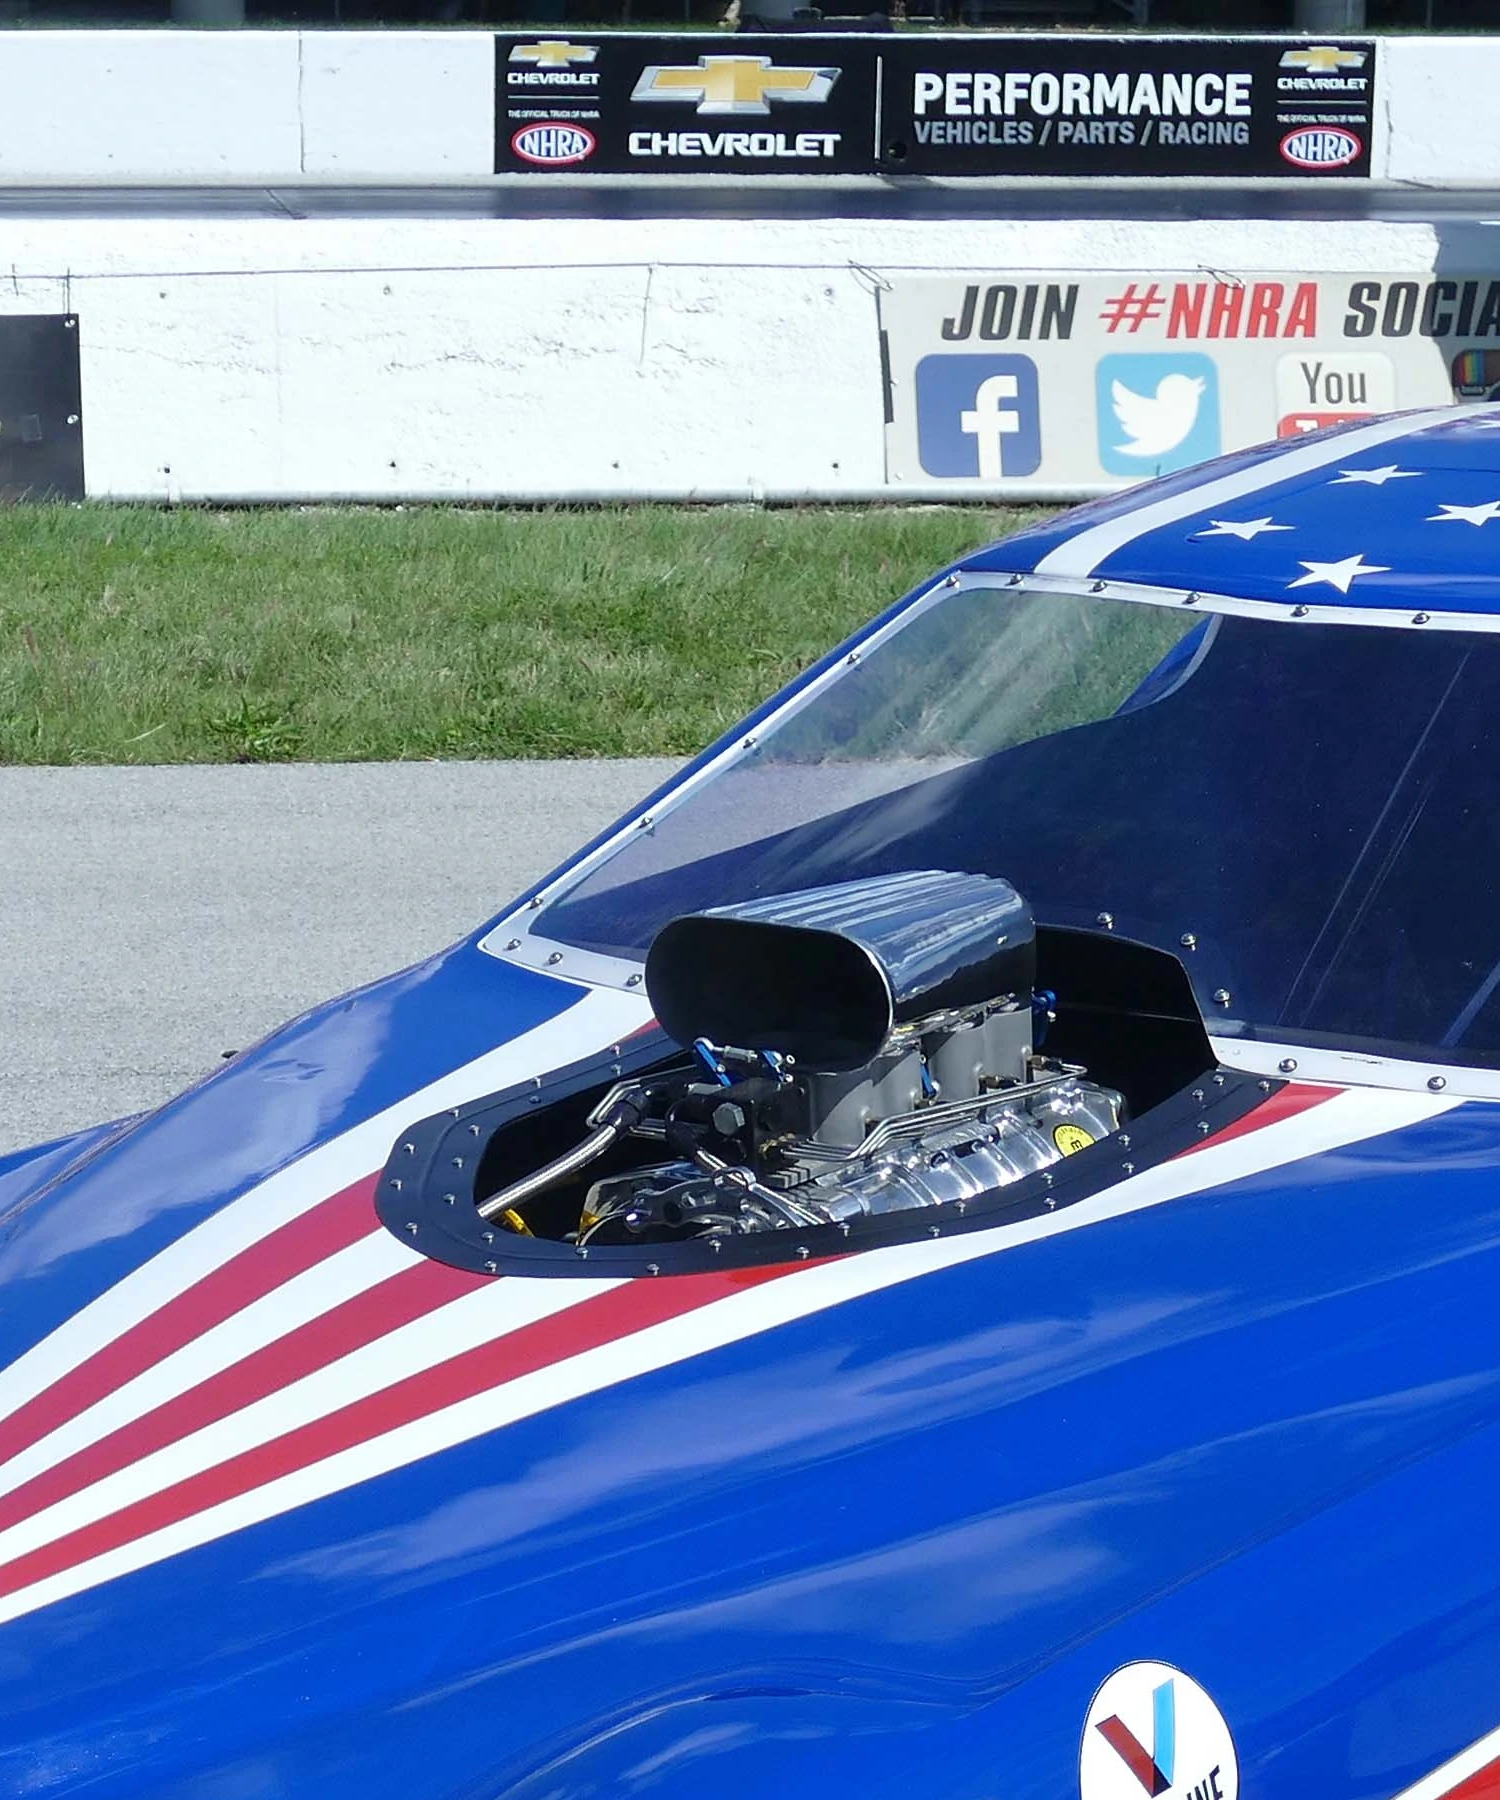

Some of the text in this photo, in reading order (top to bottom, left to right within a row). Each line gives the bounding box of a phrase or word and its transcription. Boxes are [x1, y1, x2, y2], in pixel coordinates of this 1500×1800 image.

[507, 72, 600, 85] CHEVROLET
[1276, 78, 1368, 90] CHEVROLET
[913, 72, 1252, 116] PERFORMANCE
[524, 130, 584, 156] NHRA
[628, 132, 842, 157] CHEVROLET
[914, 120, 1034, 145] VEHICLES
[1058, 120, 1135, 144] PARTS
[1158, 120, 1250, 144] RACING
[1291, 133, 1350, 160] NHRA
[941, 284, 1079, 342] JOIN
[1099, 282, 1319, 340] #NHRA
[1300, 361, 1368, 404] You
